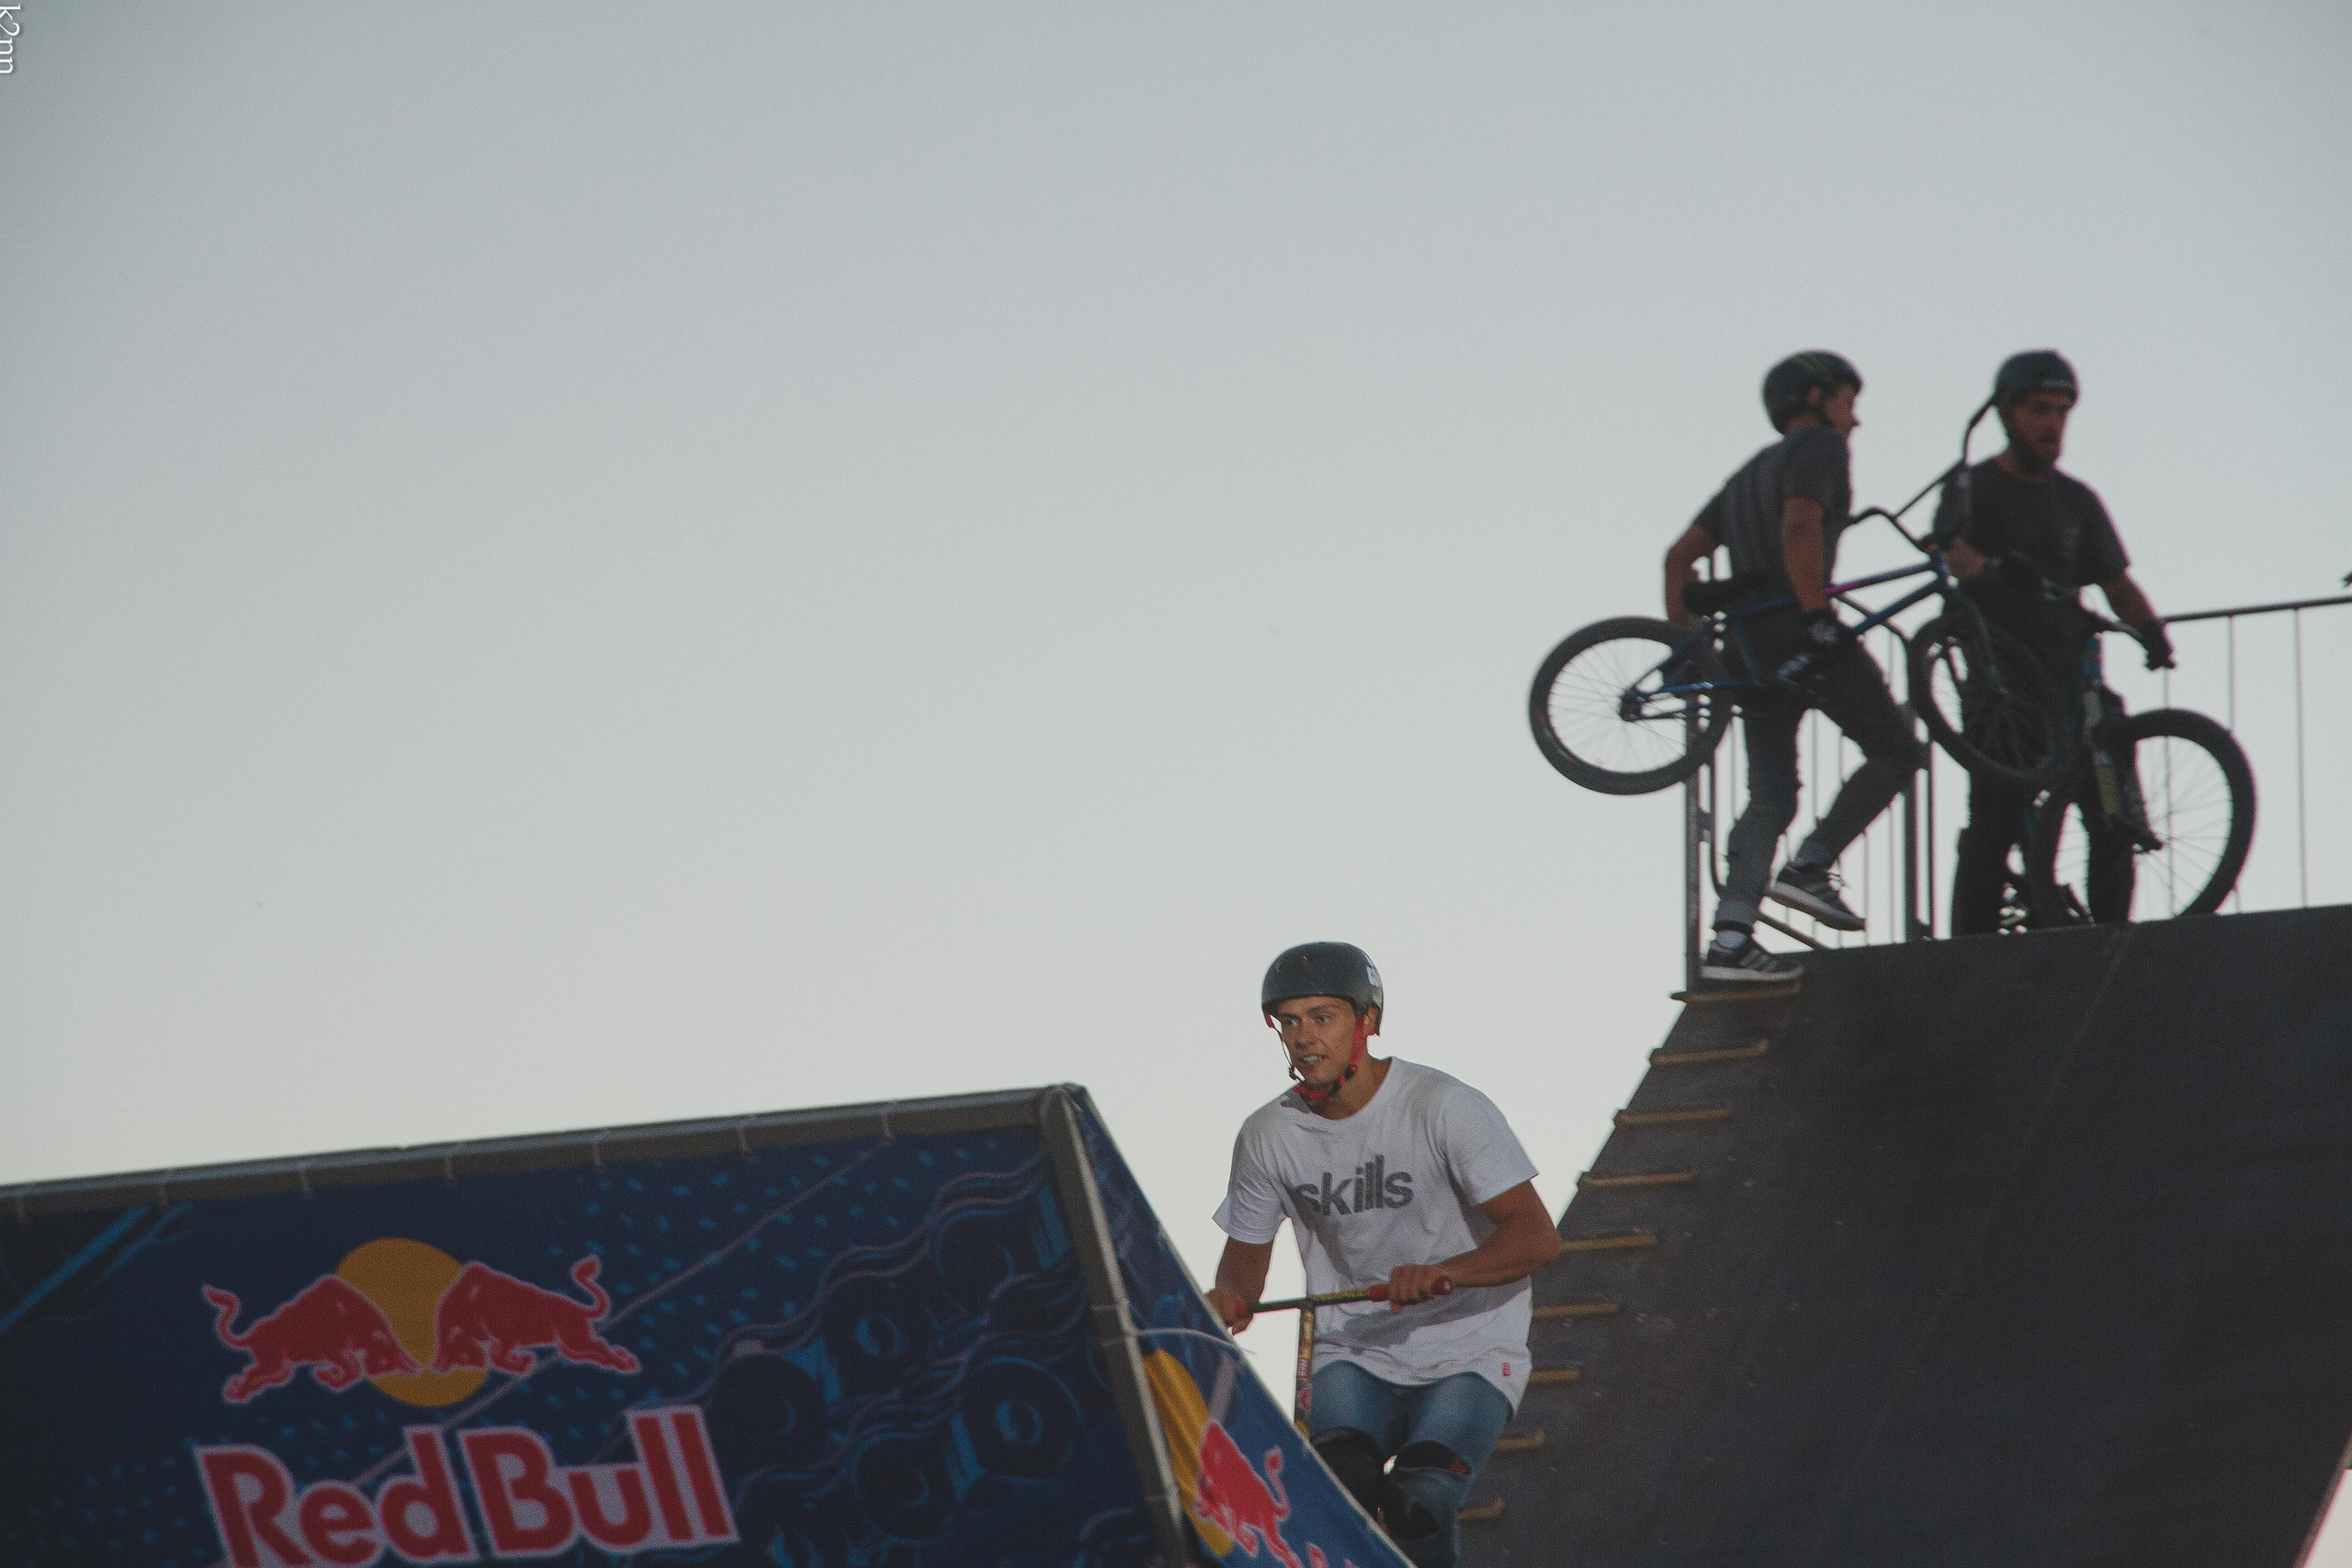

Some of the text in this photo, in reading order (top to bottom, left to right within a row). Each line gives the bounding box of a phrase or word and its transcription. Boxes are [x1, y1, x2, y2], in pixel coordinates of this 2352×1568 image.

[1291, 1154, 1416, 1216] skills
[195, 1405, 739, 1568] Red Bull
